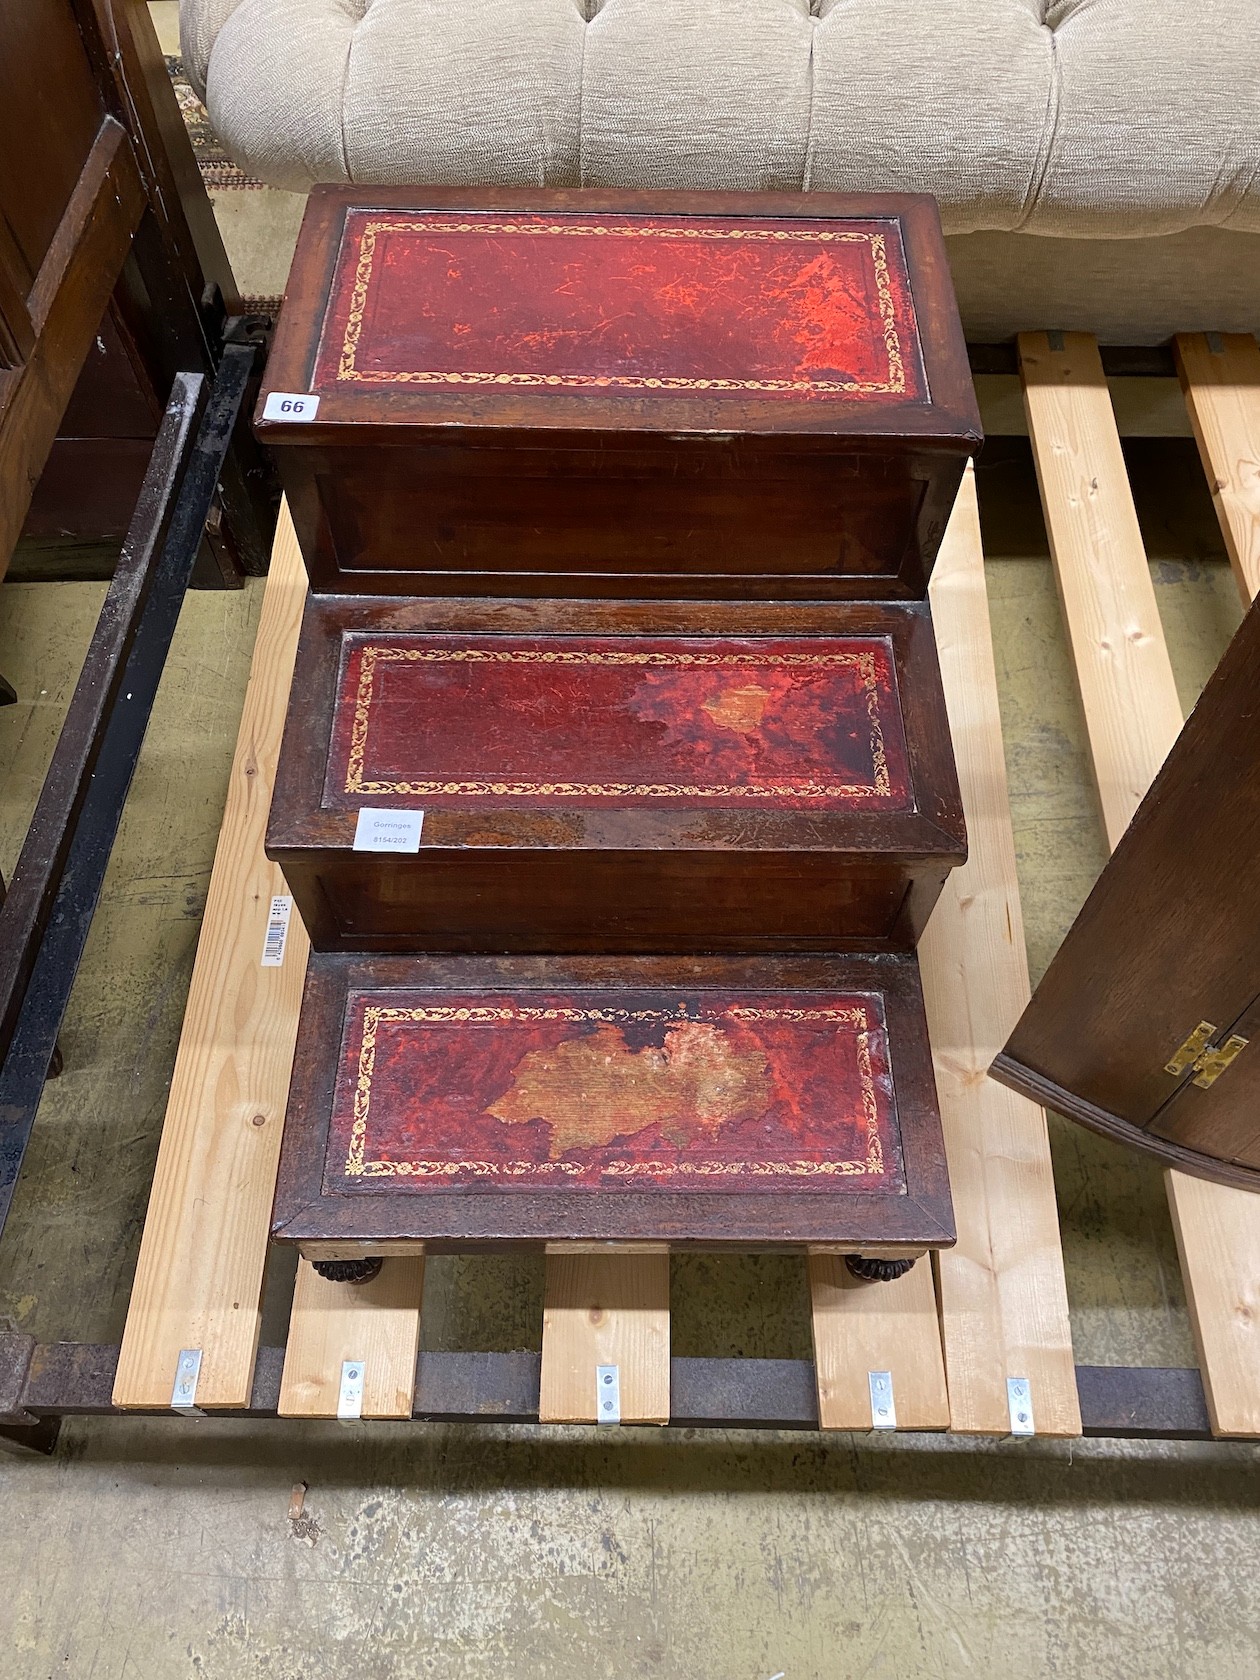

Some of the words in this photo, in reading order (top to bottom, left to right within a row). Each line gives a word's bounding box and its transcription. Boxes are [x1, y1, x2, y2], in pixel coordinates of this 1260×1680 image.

[280, 400, 305, 413] 66
[373, 821, 411, 829] Gorringes
[373, 836, 407, 844] 8154/202
